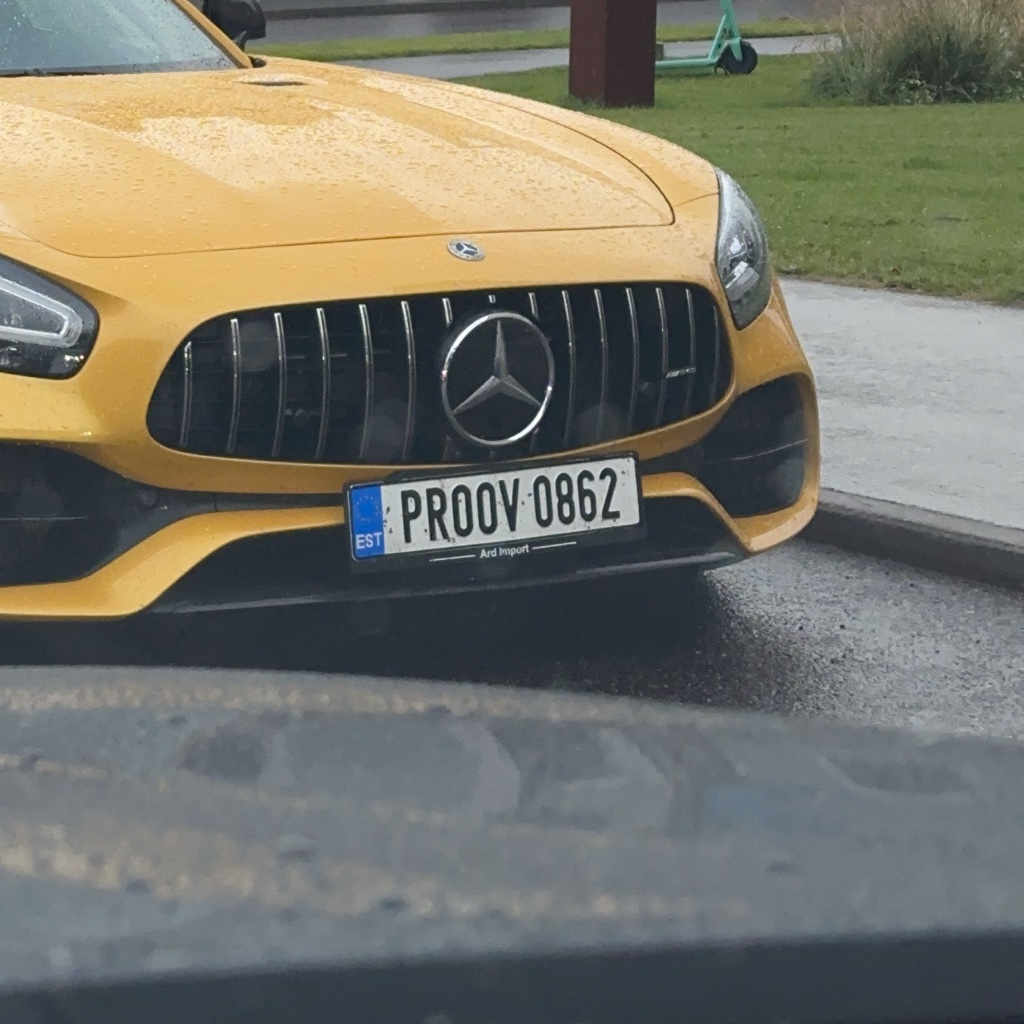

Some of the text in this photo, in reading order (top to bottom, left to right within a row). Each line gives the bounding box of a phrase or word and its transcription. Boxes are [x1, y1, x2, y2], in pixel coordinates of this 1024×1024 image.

[400, 467, 621, 544] PROOV 0862
[356, 531, 383, 550] EST
[479, 544, 529, 559] Ard Import
